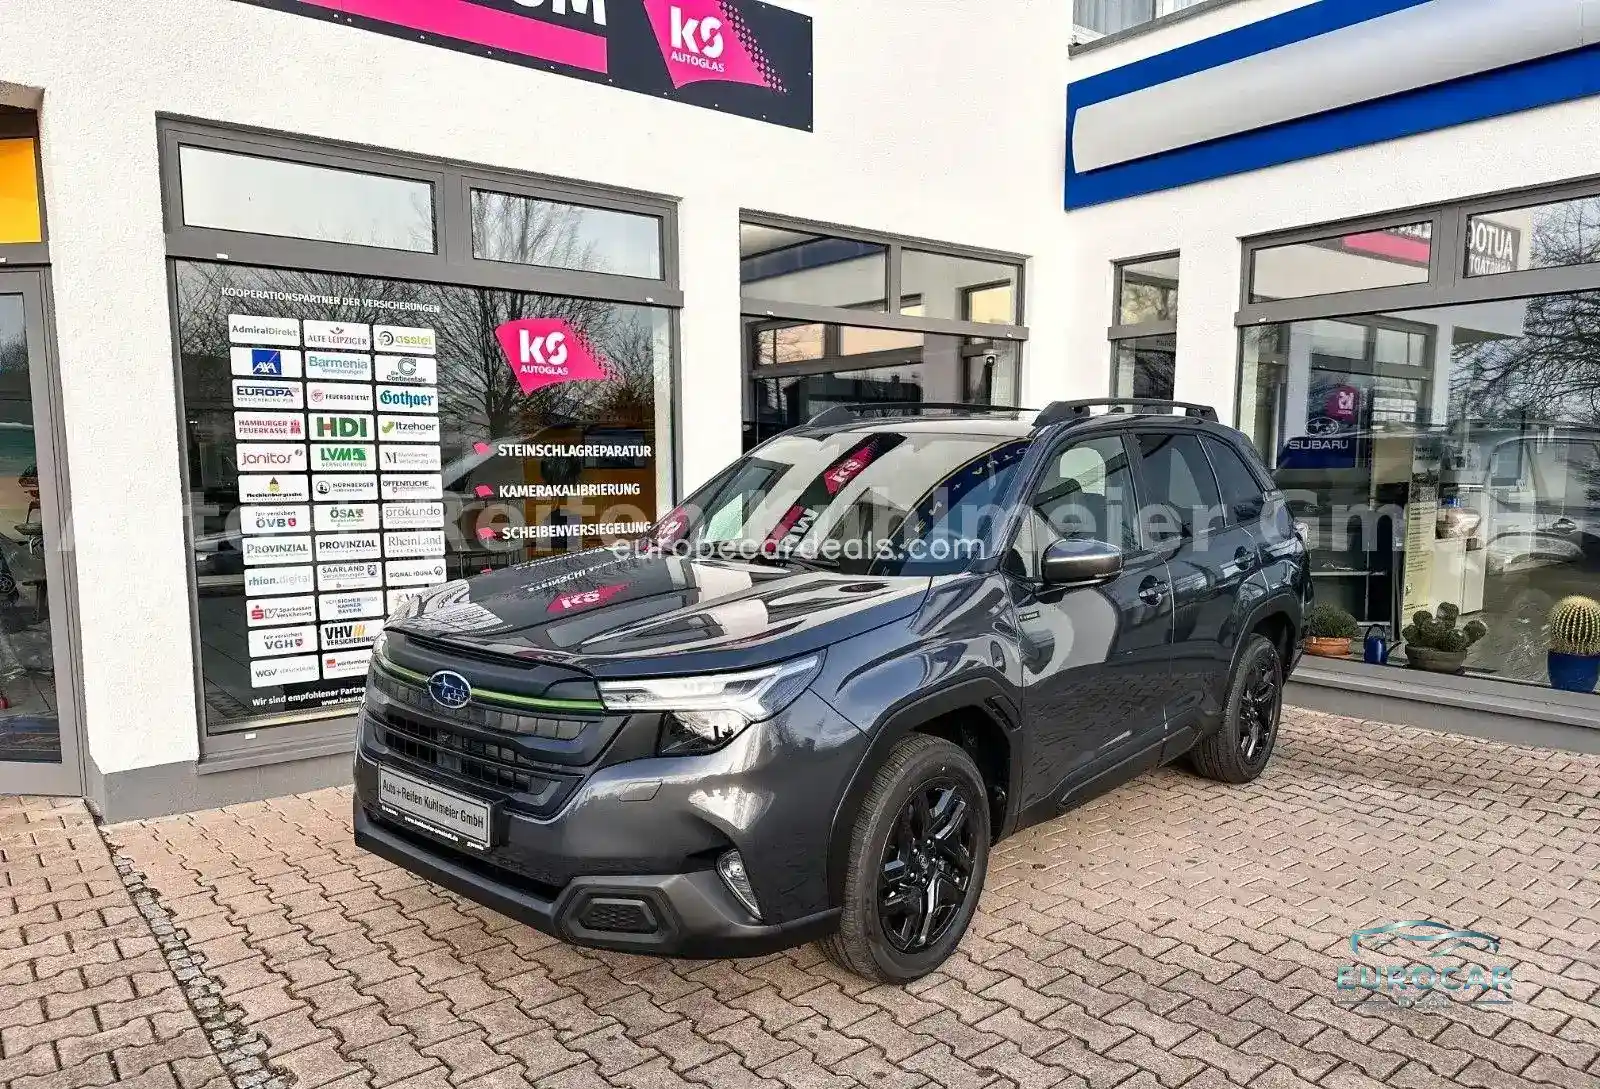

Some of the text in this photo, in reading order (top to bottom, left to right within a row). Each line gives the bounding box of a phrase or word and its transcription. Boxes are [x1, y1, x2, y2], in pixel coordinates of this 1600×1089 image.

[670, 50, 725, 73] AUTOGLAS
[221, 287, 440, 313] KOOPERATIONSPARTNER DER VERSICHERUNGEN
[232, 325, 298, 338] AdmiralDirekt
[307, 335, 367, 347] ALTE LEIPZIGER
[252, 361, 279, 375] AXA
[309, 355, 368, 370] Barmenia
[520, 365, 569, 376] AUTOGLAS
[386, 375, 427, 383] Continentale
[236, 386, 295, 397] EUROPA
[325, 393, 370, 401] FEUERSOZIETÄT
[380, 390, 435, 408] Gothaer
[317, 417, 368, 437] HDI
[395, 421, 436, 431] Itzehoer
[498, 444, 652, 457] STEINSCHLAGREPARATUR
[1289, 440, 1349, 450] SUBARU
[241, 452, 292, 466] janitos
[320, 448, 352, 461] LVM
[499, 483, 641, 498] KAMERAKALIBRIERUNG
[329, 507, 356, 518] ÖSA
[255, 517, 286, 528] ÖVB
[502, 521, 652, 539] SCHEIBENVERSIEGELUNG
[319, 539, 378, 550] PROVINZIAL
[322, 565, 365, 574] SAARLAND
[325, 625, 353, 640] VHV
[264, 639, 294, 650] VGH
[326, 636, 376, 646] VERSICHERUNG
[255, 668, 277, 678] WGV
[269, 695, 286, 705] sind
[288, 690, 339, 702] empfohlener
[340, 686, 366, 696] Partne
[383, 779, 395, 795] Auto
[402, 787, 422, 805] Reifen
[461, 809, 483, 828] GmbH
